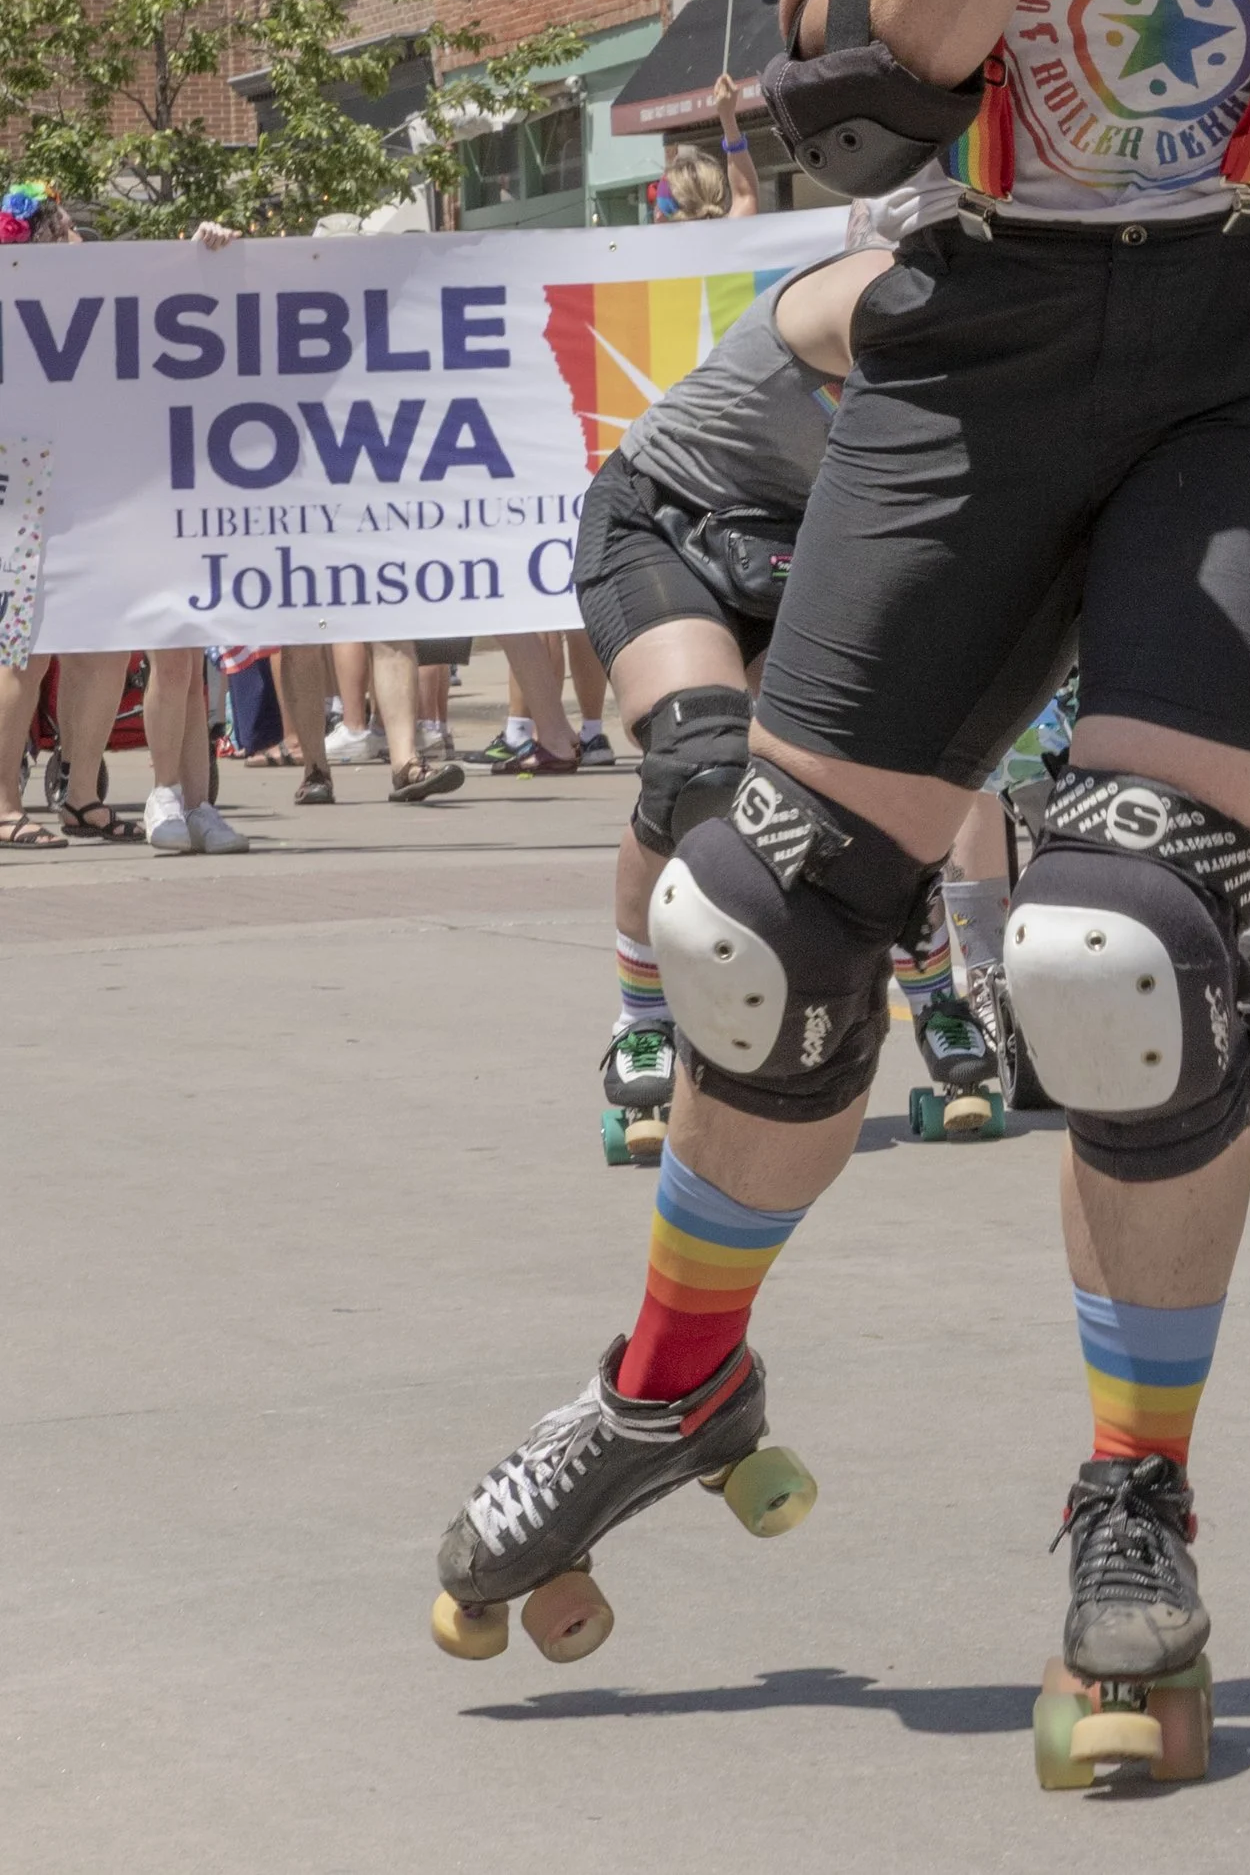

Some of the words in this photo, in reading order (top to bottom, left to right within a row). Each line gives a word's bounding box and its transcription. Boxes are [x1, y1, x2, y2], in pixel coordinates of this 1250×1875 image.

[1031, 58, 1144, 161] ROLLER
[0, 285, 511, 384] VISIBLE
[169, 397, 515, 490] IOWA
[173, 502, 342, 539] LIBERTY
[356, 499, 445, 534] AND
[188, 545, 505, 612] Johnson
[1057, 787, 1109, 828] SMITH
